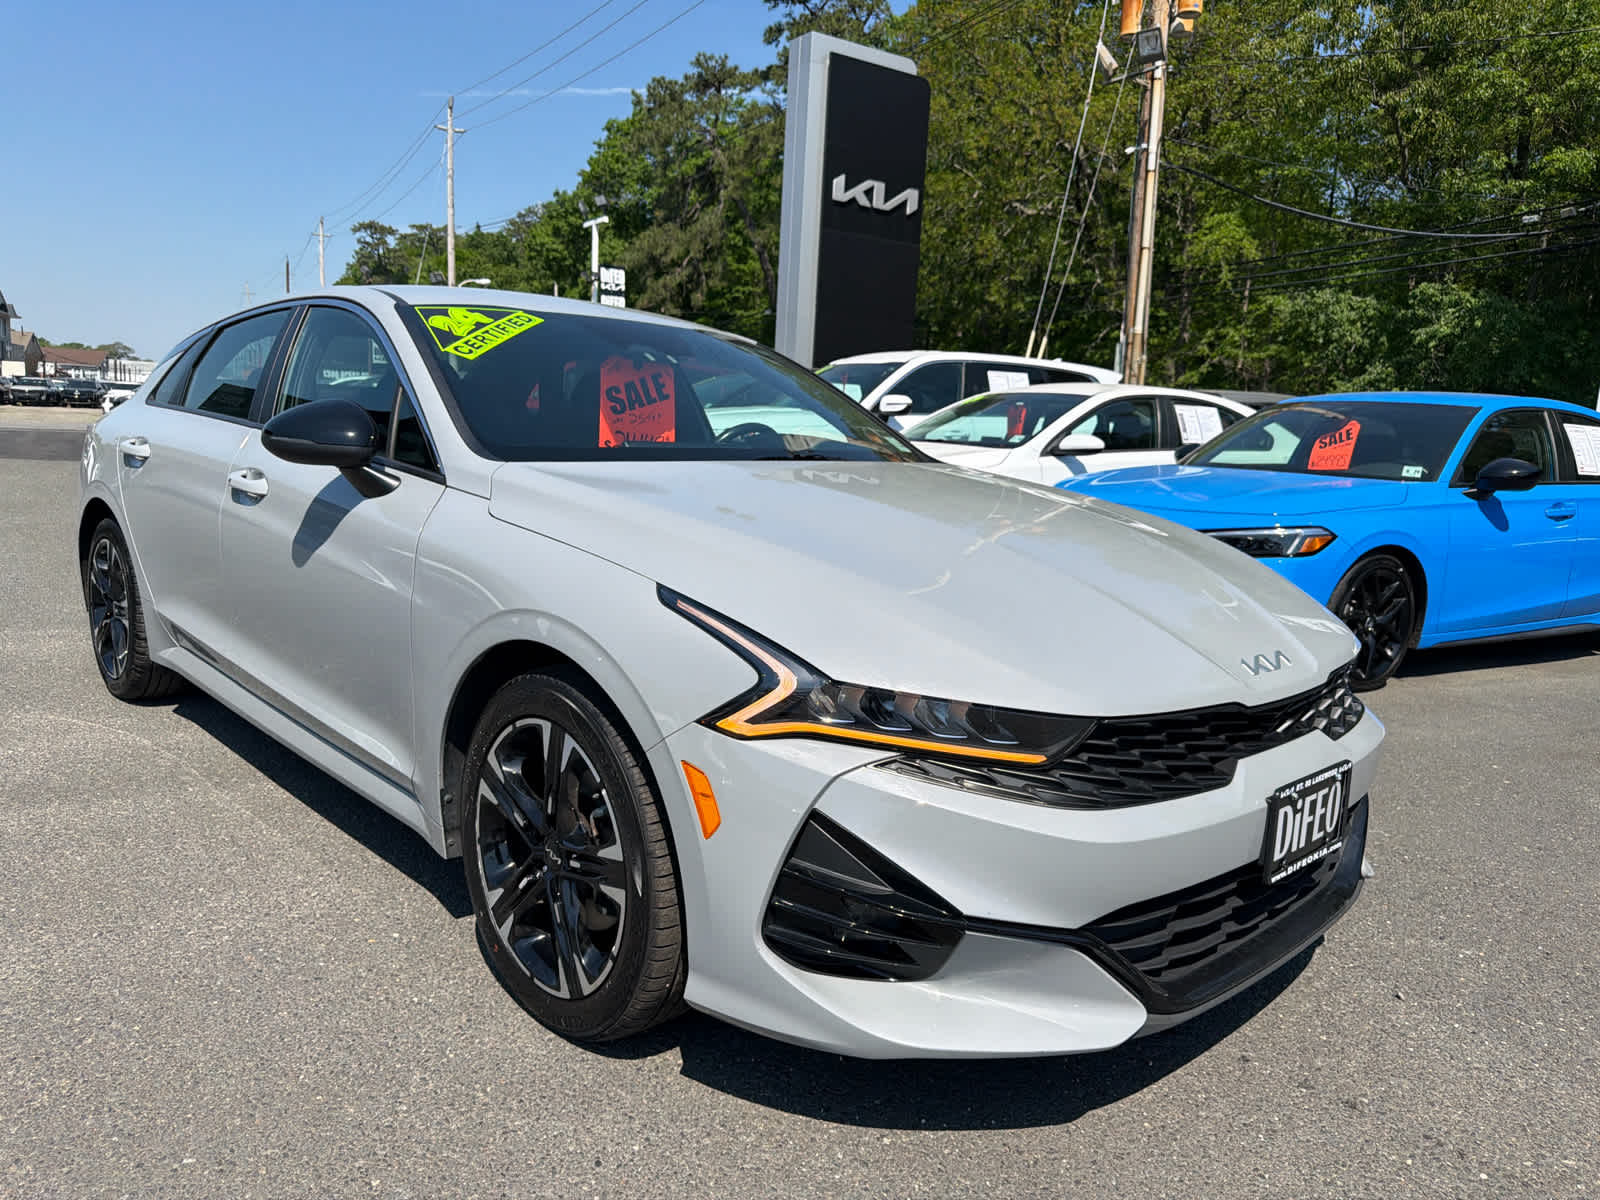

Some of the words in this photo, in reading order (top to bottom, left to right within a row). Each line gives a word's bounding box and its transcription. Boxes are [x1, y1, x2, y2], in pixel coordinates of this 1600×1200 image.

[832, 173, 919, 215] KIA
[429, 307, 495, 336] 24
[453, 314, 534, 356] CERTIFIED
[605, 372, 671, 415] SALE
[1318, 427, 1354, 449] SALE
[1241, 650, 1293, 676] KIA
